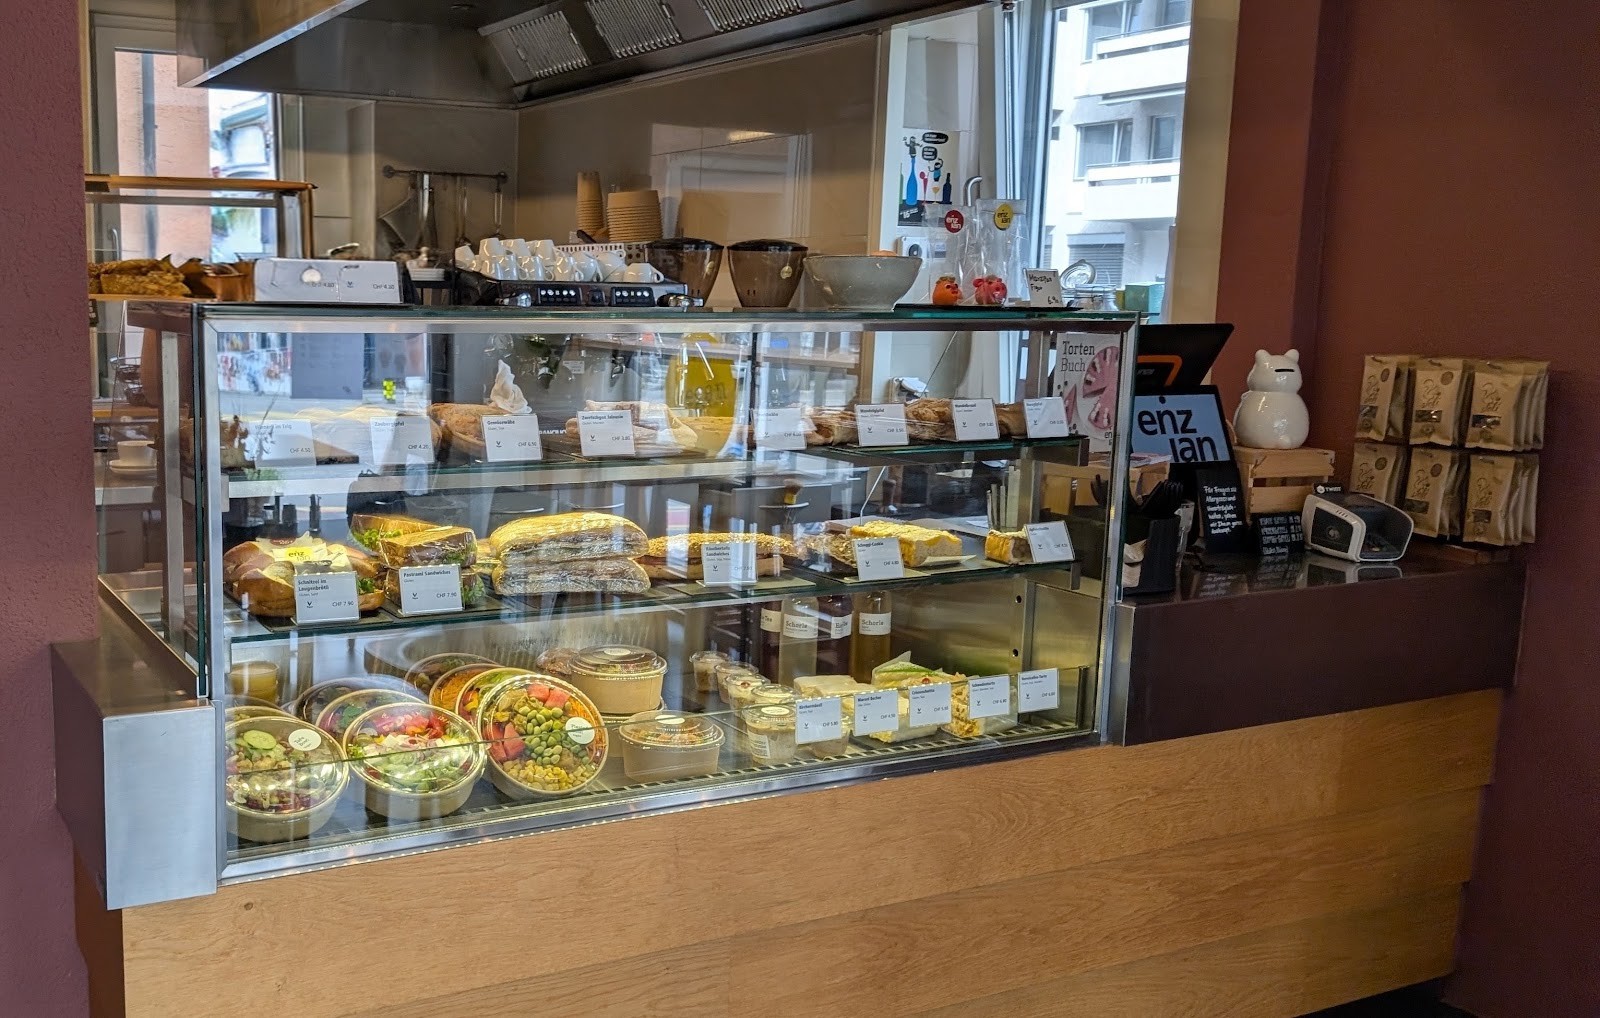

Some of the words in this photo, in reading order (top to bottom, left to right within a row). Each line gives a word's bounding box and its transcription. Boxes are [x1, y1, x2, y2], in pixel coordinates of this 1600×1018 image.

[1062, 340, 1095, 356] Torten
[1060, 358, 1086, 372] Buch
[1137, 399, 1198, 435] enz
